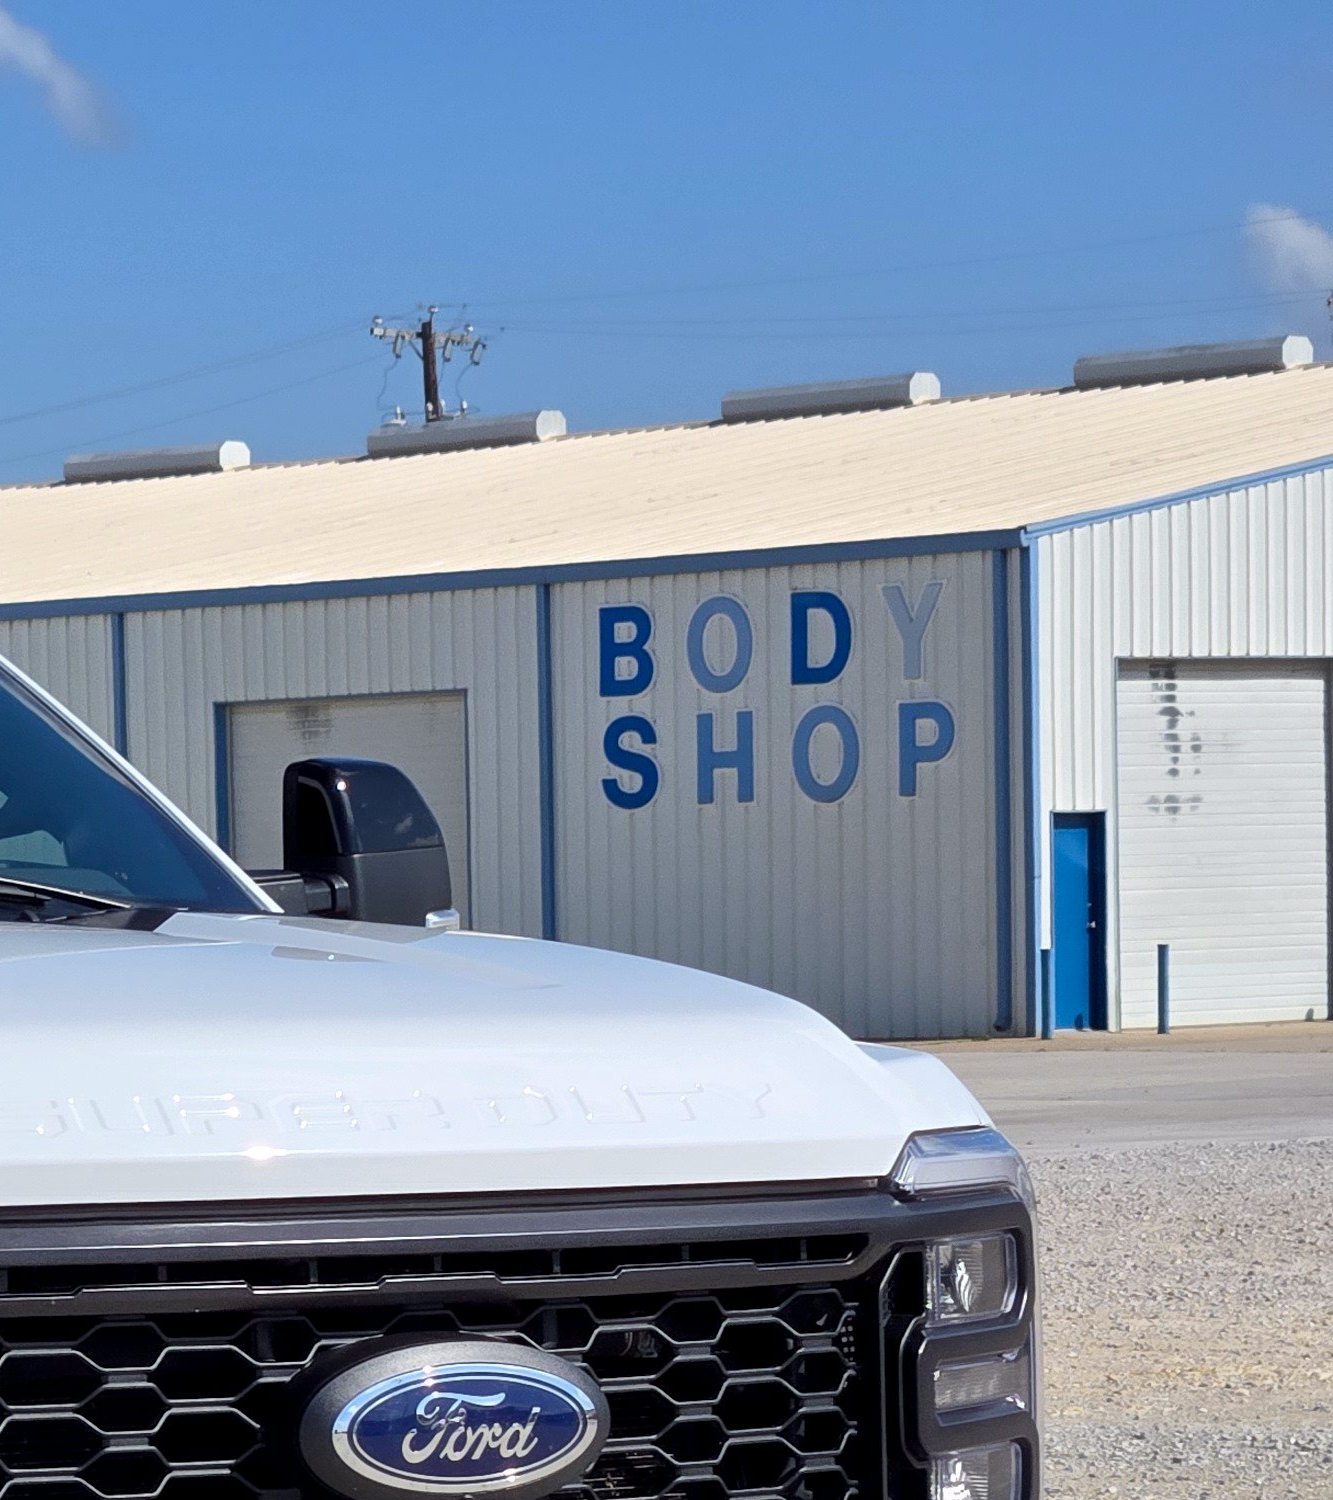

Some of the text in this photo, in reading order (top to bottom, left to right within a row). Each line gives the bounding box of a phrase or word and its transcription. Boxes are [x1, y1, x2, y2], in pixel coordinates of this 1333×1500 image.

[598, 582, 945, 698] BODY
[601, 700, 956, 810] SHOP
[401, 1391, 542, 1464] Ford
